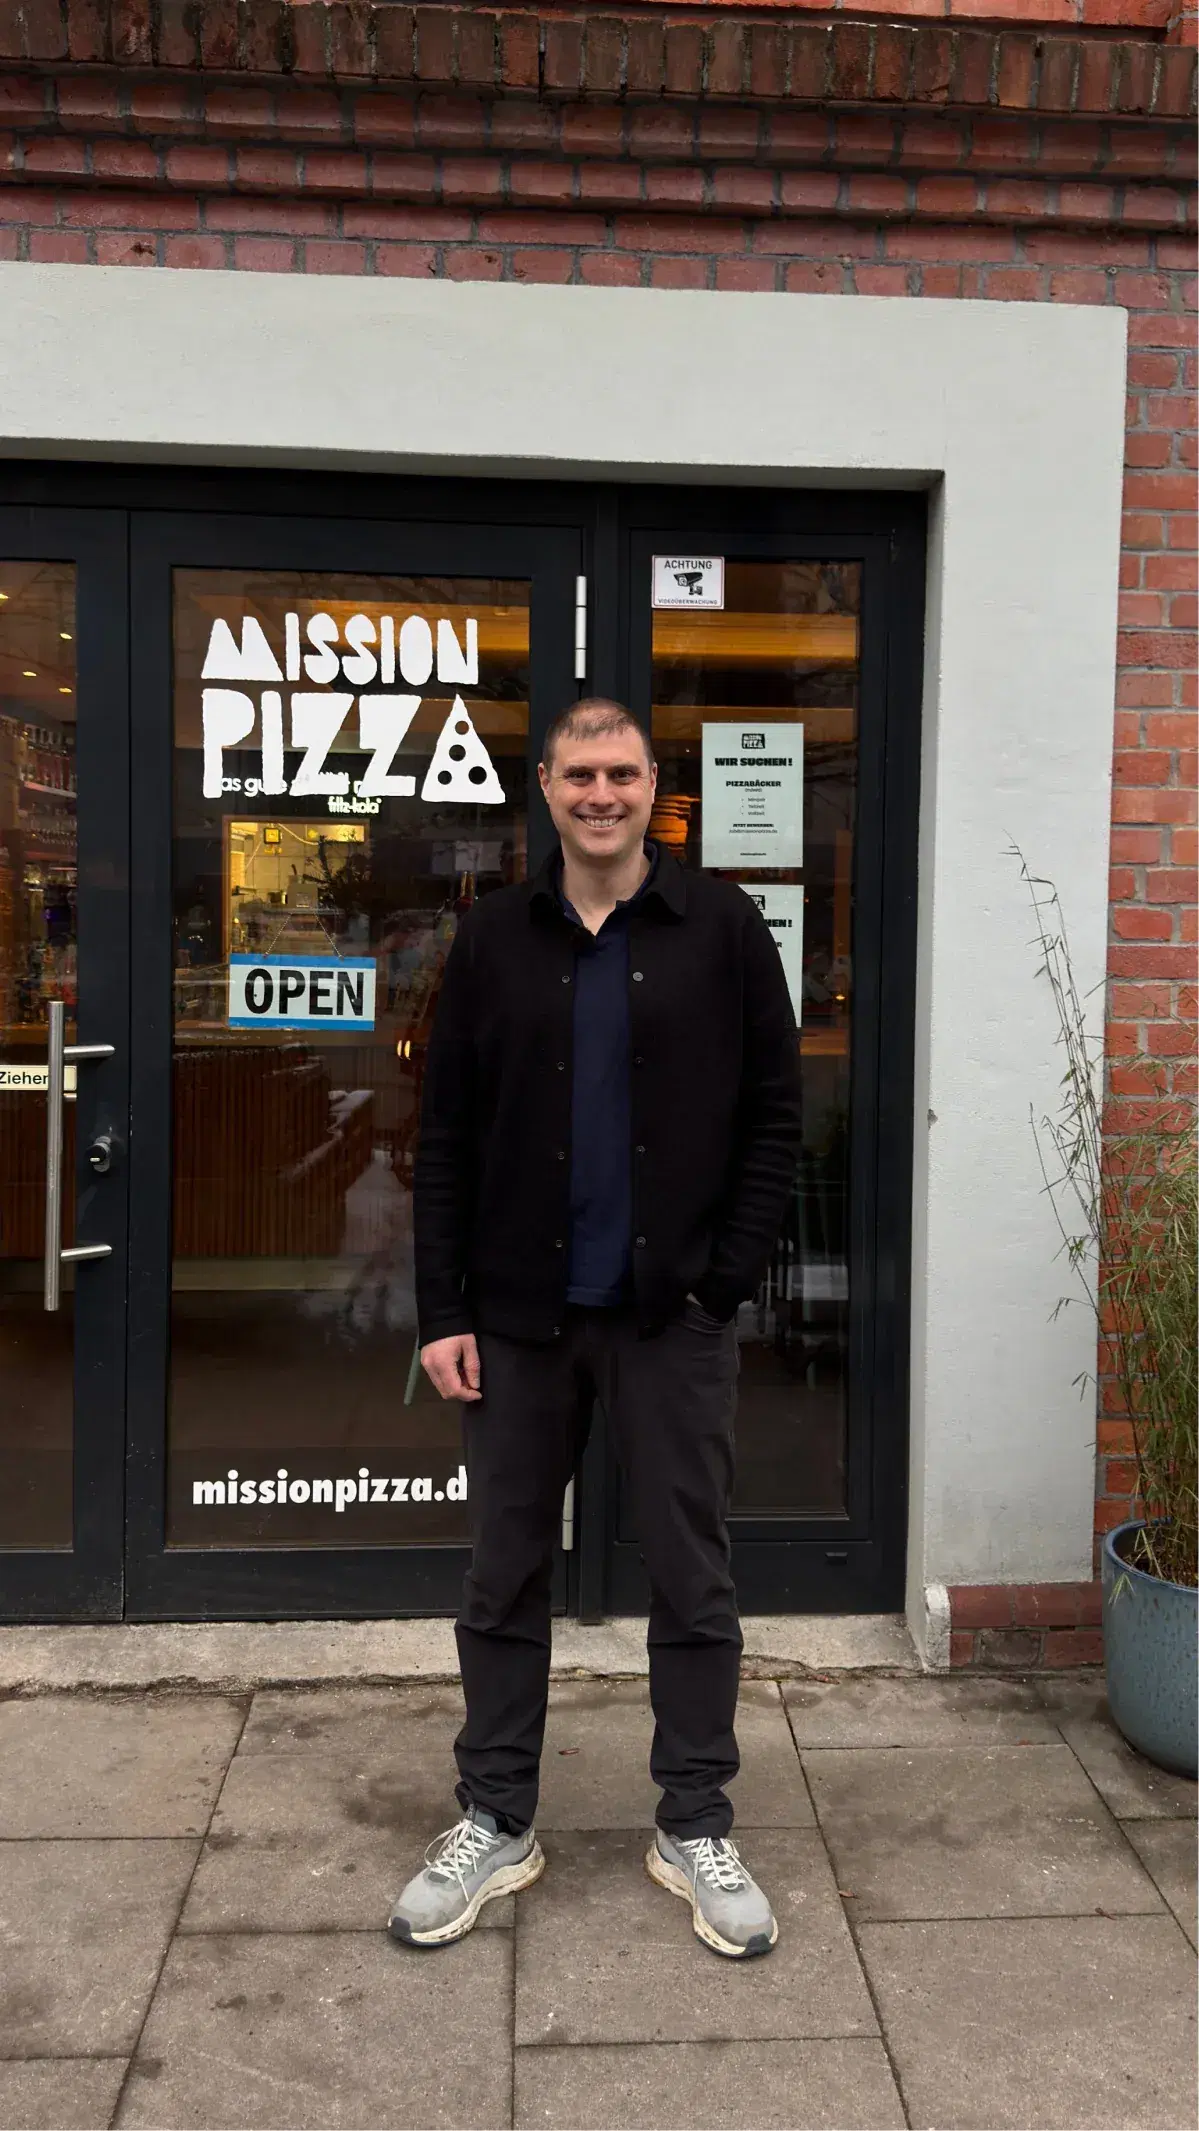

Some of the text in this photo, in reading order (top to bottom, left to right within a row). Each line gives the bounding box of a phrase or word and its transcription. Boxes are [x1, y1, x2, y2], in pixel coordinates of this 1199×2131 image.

[664, 560, 713, 570] ACHTUNG
[201, 612, 479, 686] MISSION
[202, 688, 506, 804] PIZZA
[715, 758, 738, 766] WIR
[221, 776, 242, 792] as
[245, 968, 364, 1016] OPEN
[193, 1465, 468, 1512] missionpizza.d
